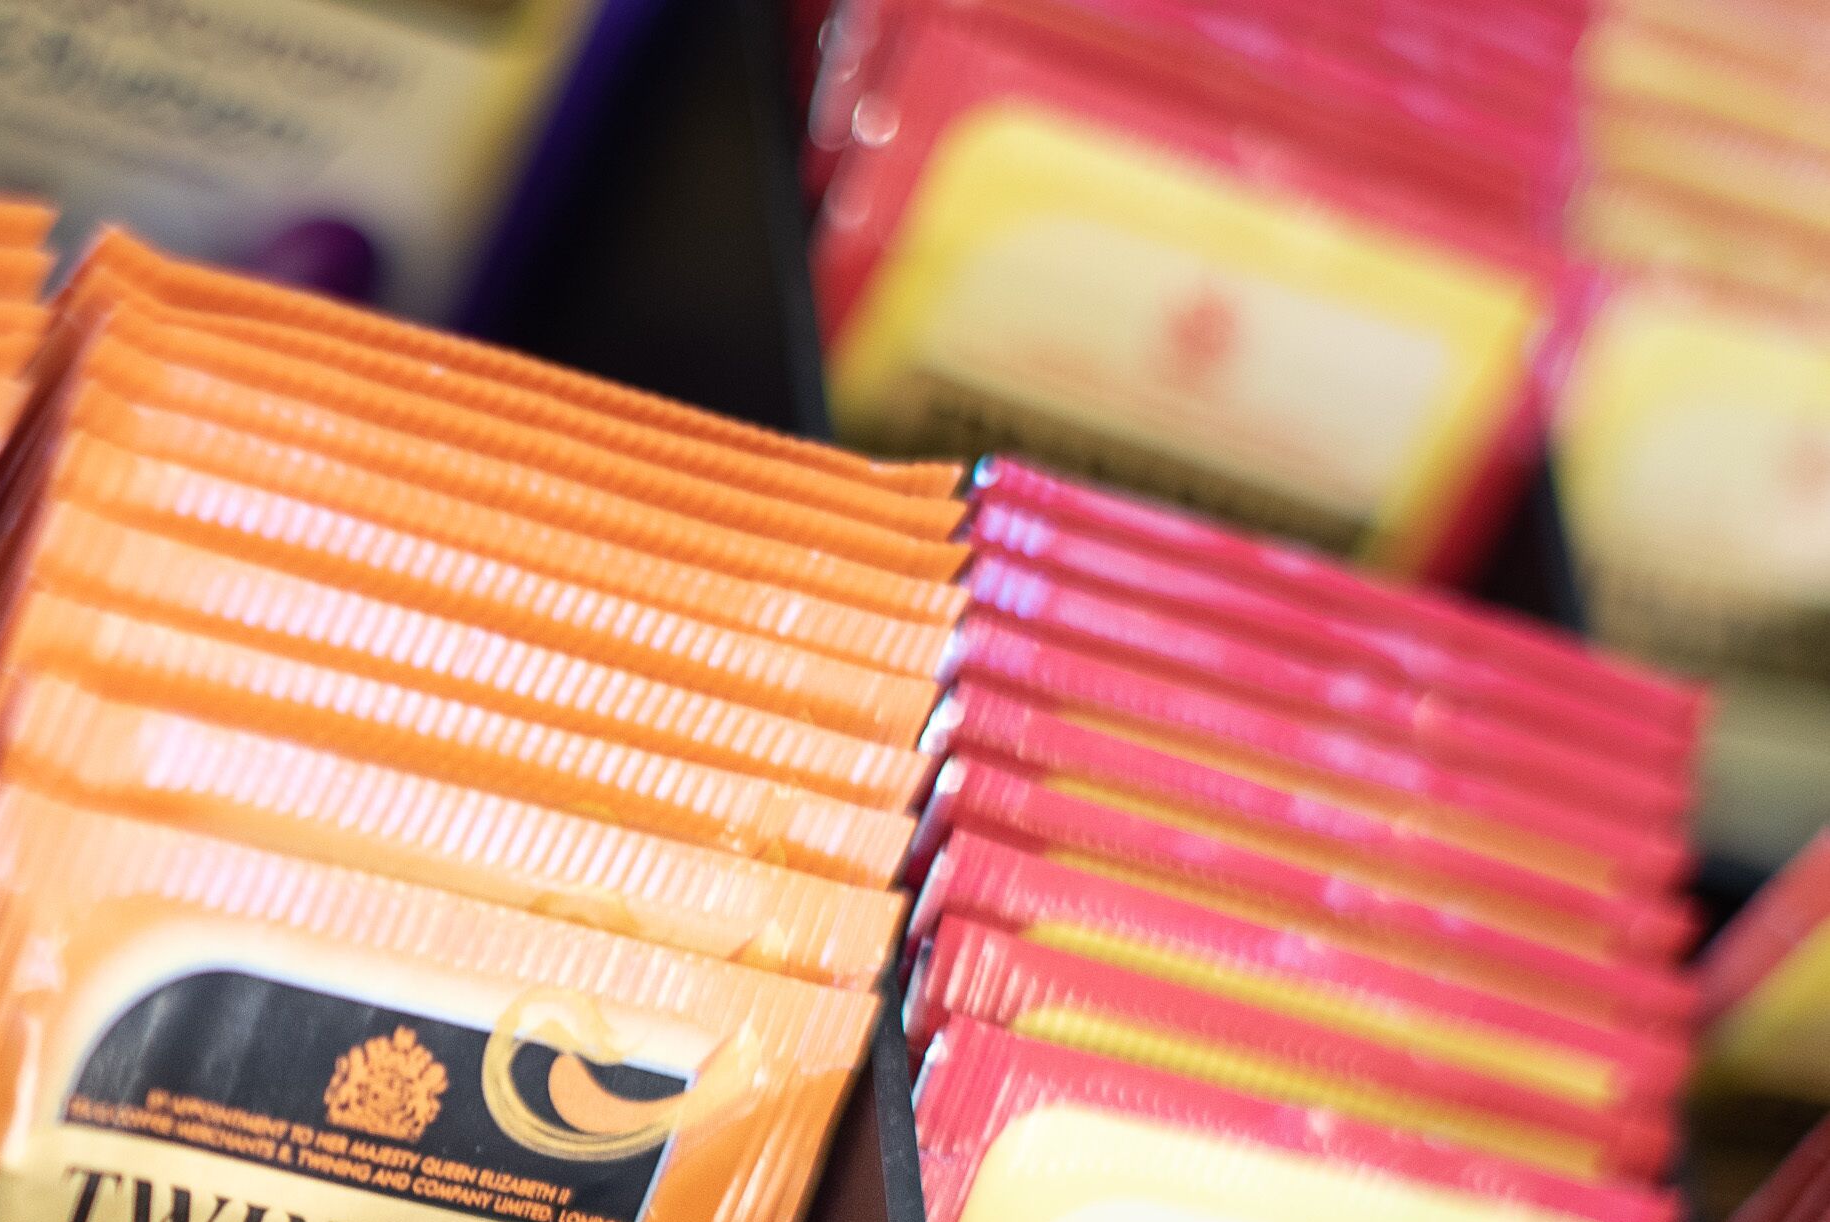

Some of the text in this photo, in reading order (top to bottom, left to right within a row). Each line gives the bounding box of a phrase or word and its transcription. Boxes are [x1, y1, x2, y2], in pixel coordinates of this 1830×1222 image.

[290, 1122, 315, 1147] TO
[349, 1139, 421, 1171] MAJESTY
[421, 1155, 477, 1185] QUEEN
[478, 1167, 558, 1204] ELIZABETH
[297, 1149, 371, 1184] TWINING
[371, 1168, 412, 1192] AND
[412, 1176, 493, 1211] COMPANY
